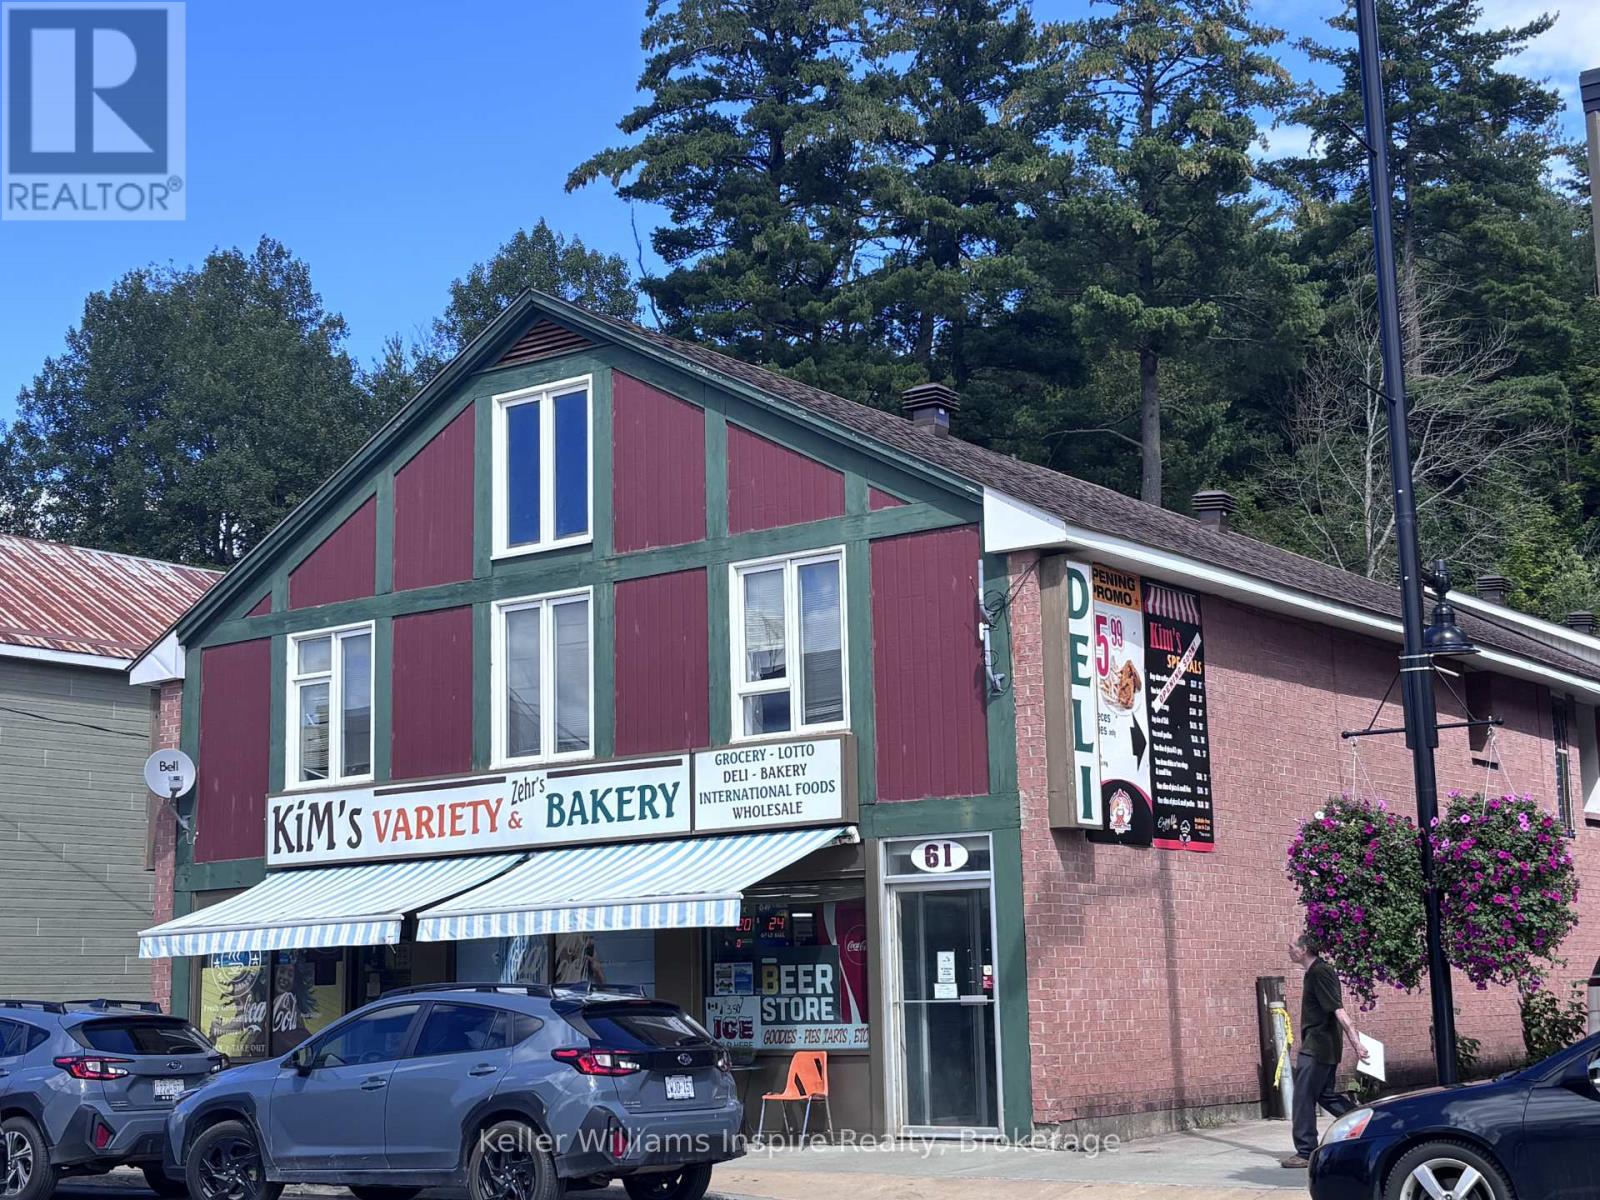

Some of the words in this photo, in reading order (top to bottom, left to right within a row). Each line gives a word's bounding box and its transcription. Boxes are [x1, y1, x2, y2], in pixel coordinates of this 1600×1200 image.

[1150, 622, 1182, 653] Kim's
[1167, 654, 1201, 674] SPEALS
[1067, 567, 1094, 819] DELI
[160, 761, 179, 771] Bell
[714, 748, 766, 766] GROCERY
[778, 744, 815, 760] LOTTO
[723, 769, 748, 783] DELI
[760, 764, 807, 780] BAKERY
[511, 776, 546, 805] Zehr's
[699, 784, 792, 805] INTERNATIONAL
[795, 780, 836, 796] FOODS
[372, 797, 504, 844] VARIETY
[507, 810, 523, 830] &
[546, 781, 681, 828] BAKERY
[732, 801, 803, 820] WHOLESALE
[924, 843, 952, 868] 61
[769, 917, 785, 930] 24
[762, 963, 834, 995] BEER
[762, 997, 834, 1022] STORE
[713, 1016, 754, 1040] ICE
[763, 1029, 797, 1045] GOODIES
